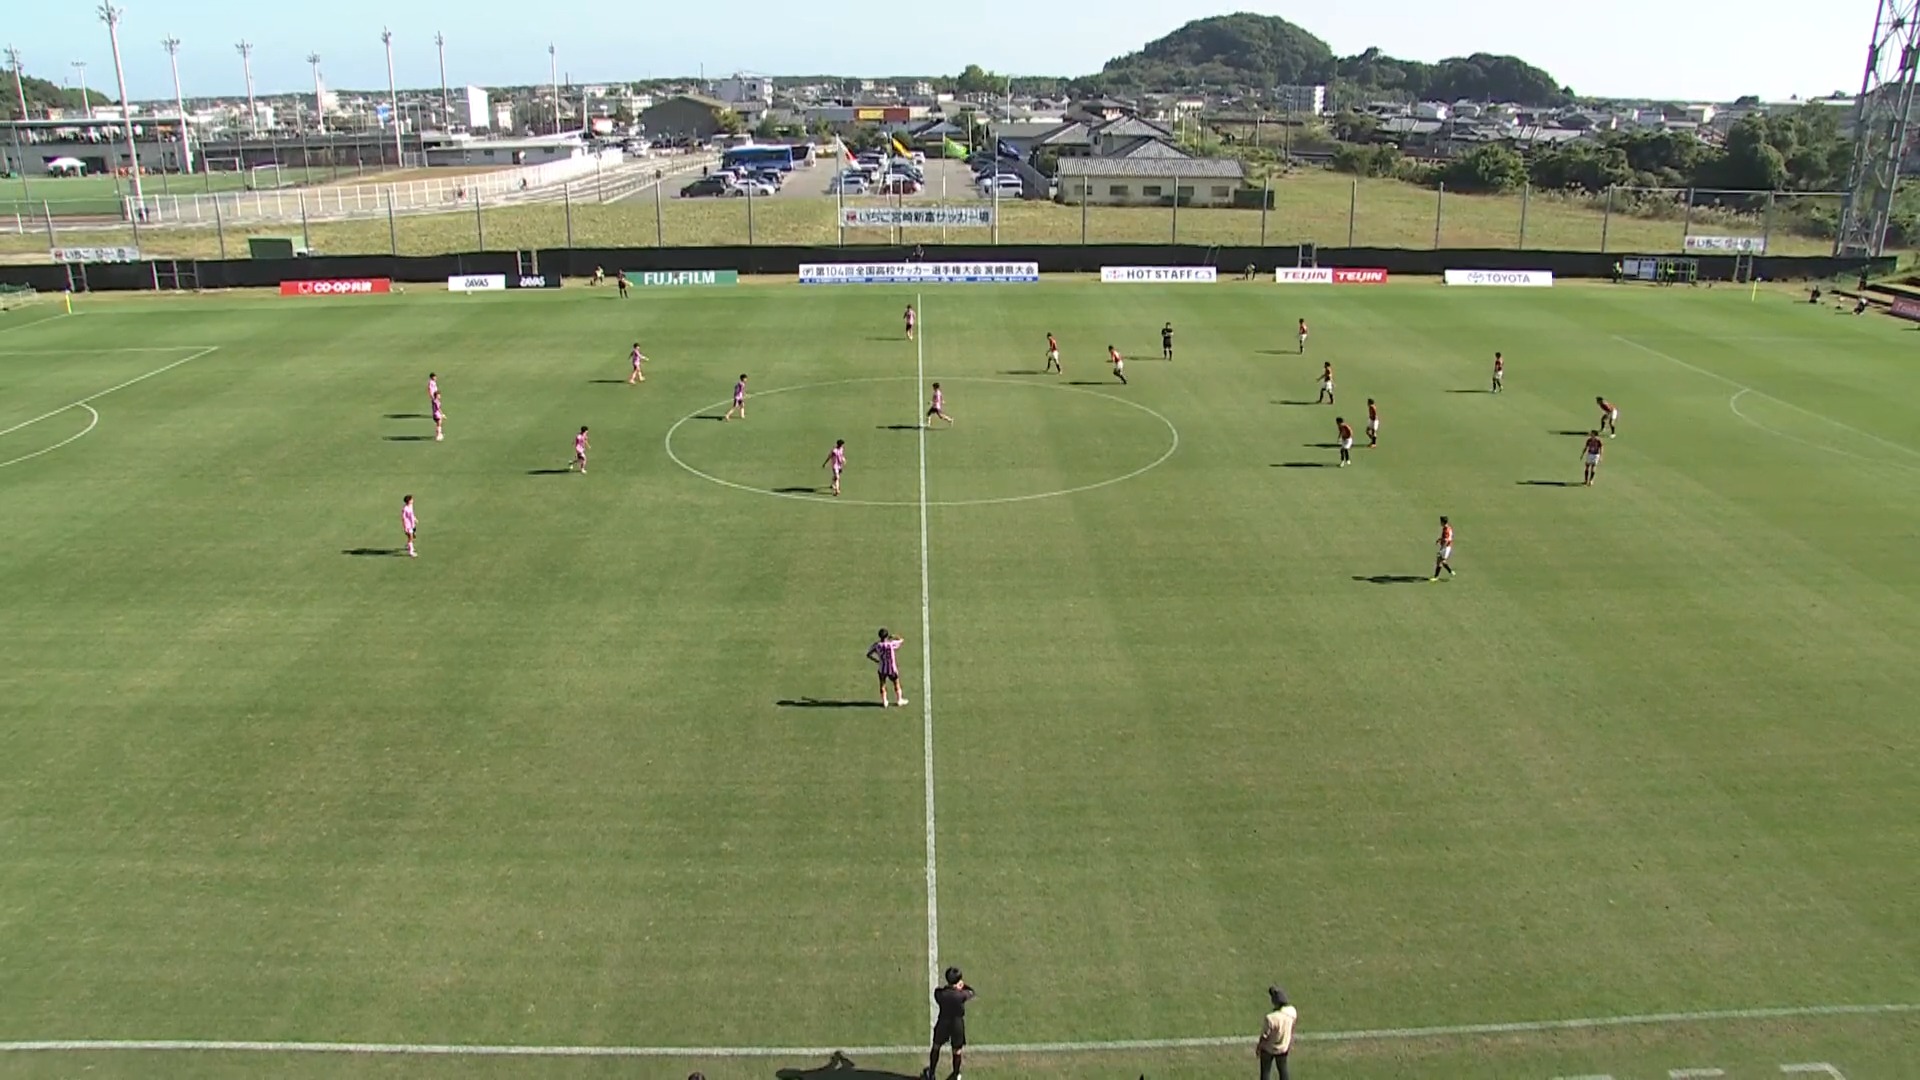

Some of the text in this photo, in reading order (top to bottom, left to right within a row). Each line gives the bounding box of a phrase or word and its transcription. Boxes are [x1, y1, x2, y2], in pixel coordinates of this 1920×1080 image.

[643, 270, 716, 286] FUJIFILM
[1126, 269, 1152, 280] HOT
[1155, 269, 1193, 280] STAFF
[1283, 271, 1328, 281] TEIJIN
[1336, 271, 1383, 283] TEIJIN
[1486, 272, 1531, 283] TOYOTA
